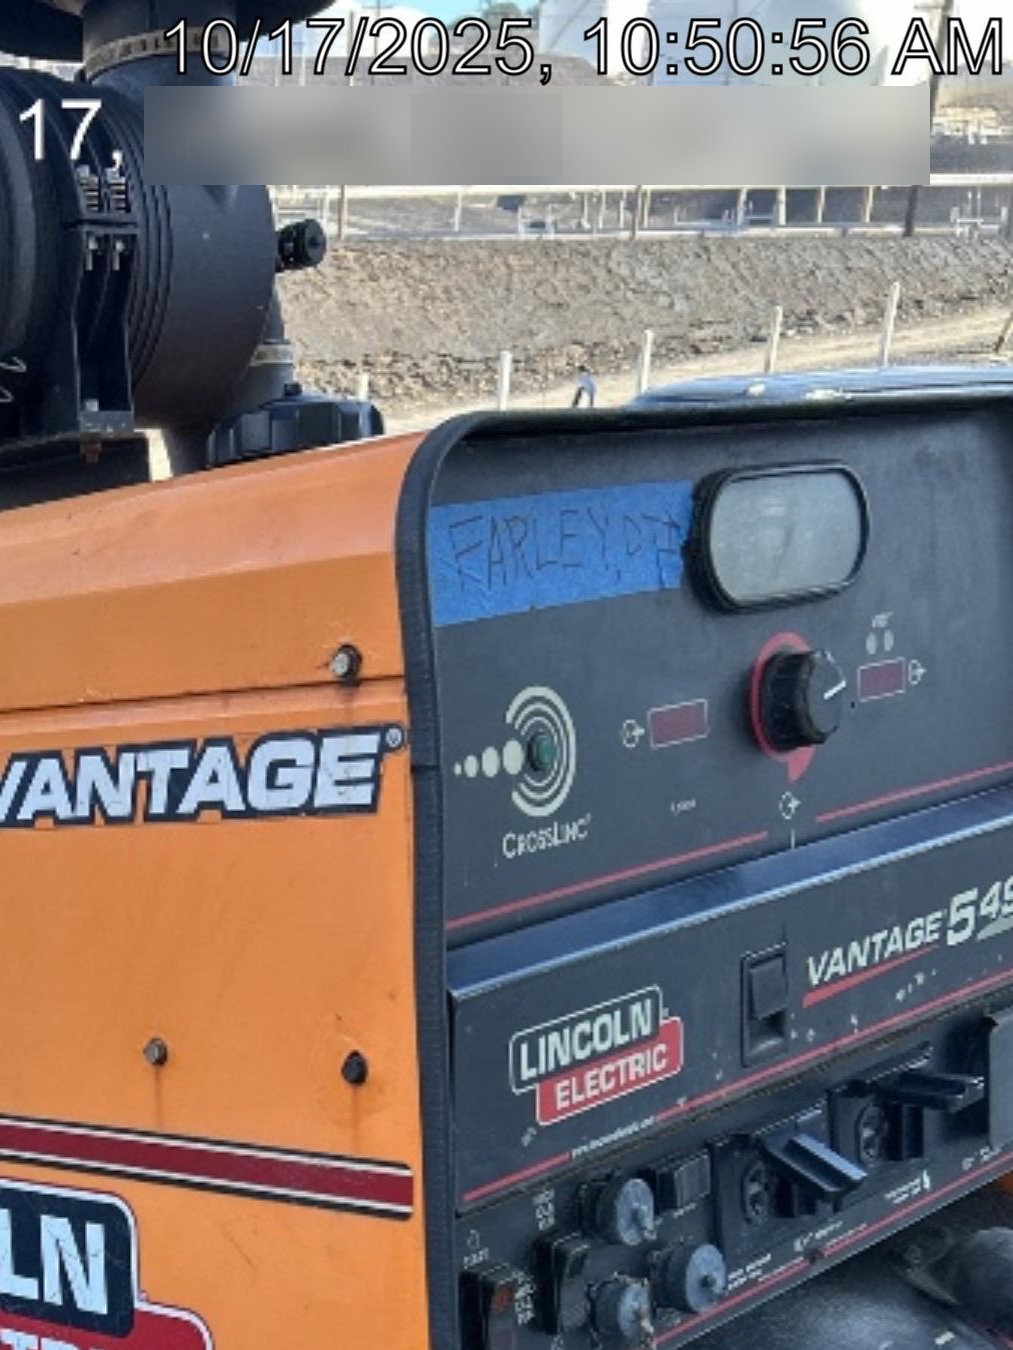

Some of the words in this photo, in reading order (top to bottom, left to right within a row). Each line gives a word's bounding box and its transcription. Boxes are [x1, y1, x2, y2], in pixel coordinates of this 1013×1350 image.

[806, 911, 943, 987] VANTAGE
[520, 998, 652, 1081] LINCOLN
[555, 1044, 668, 1111] ELECTRIC
